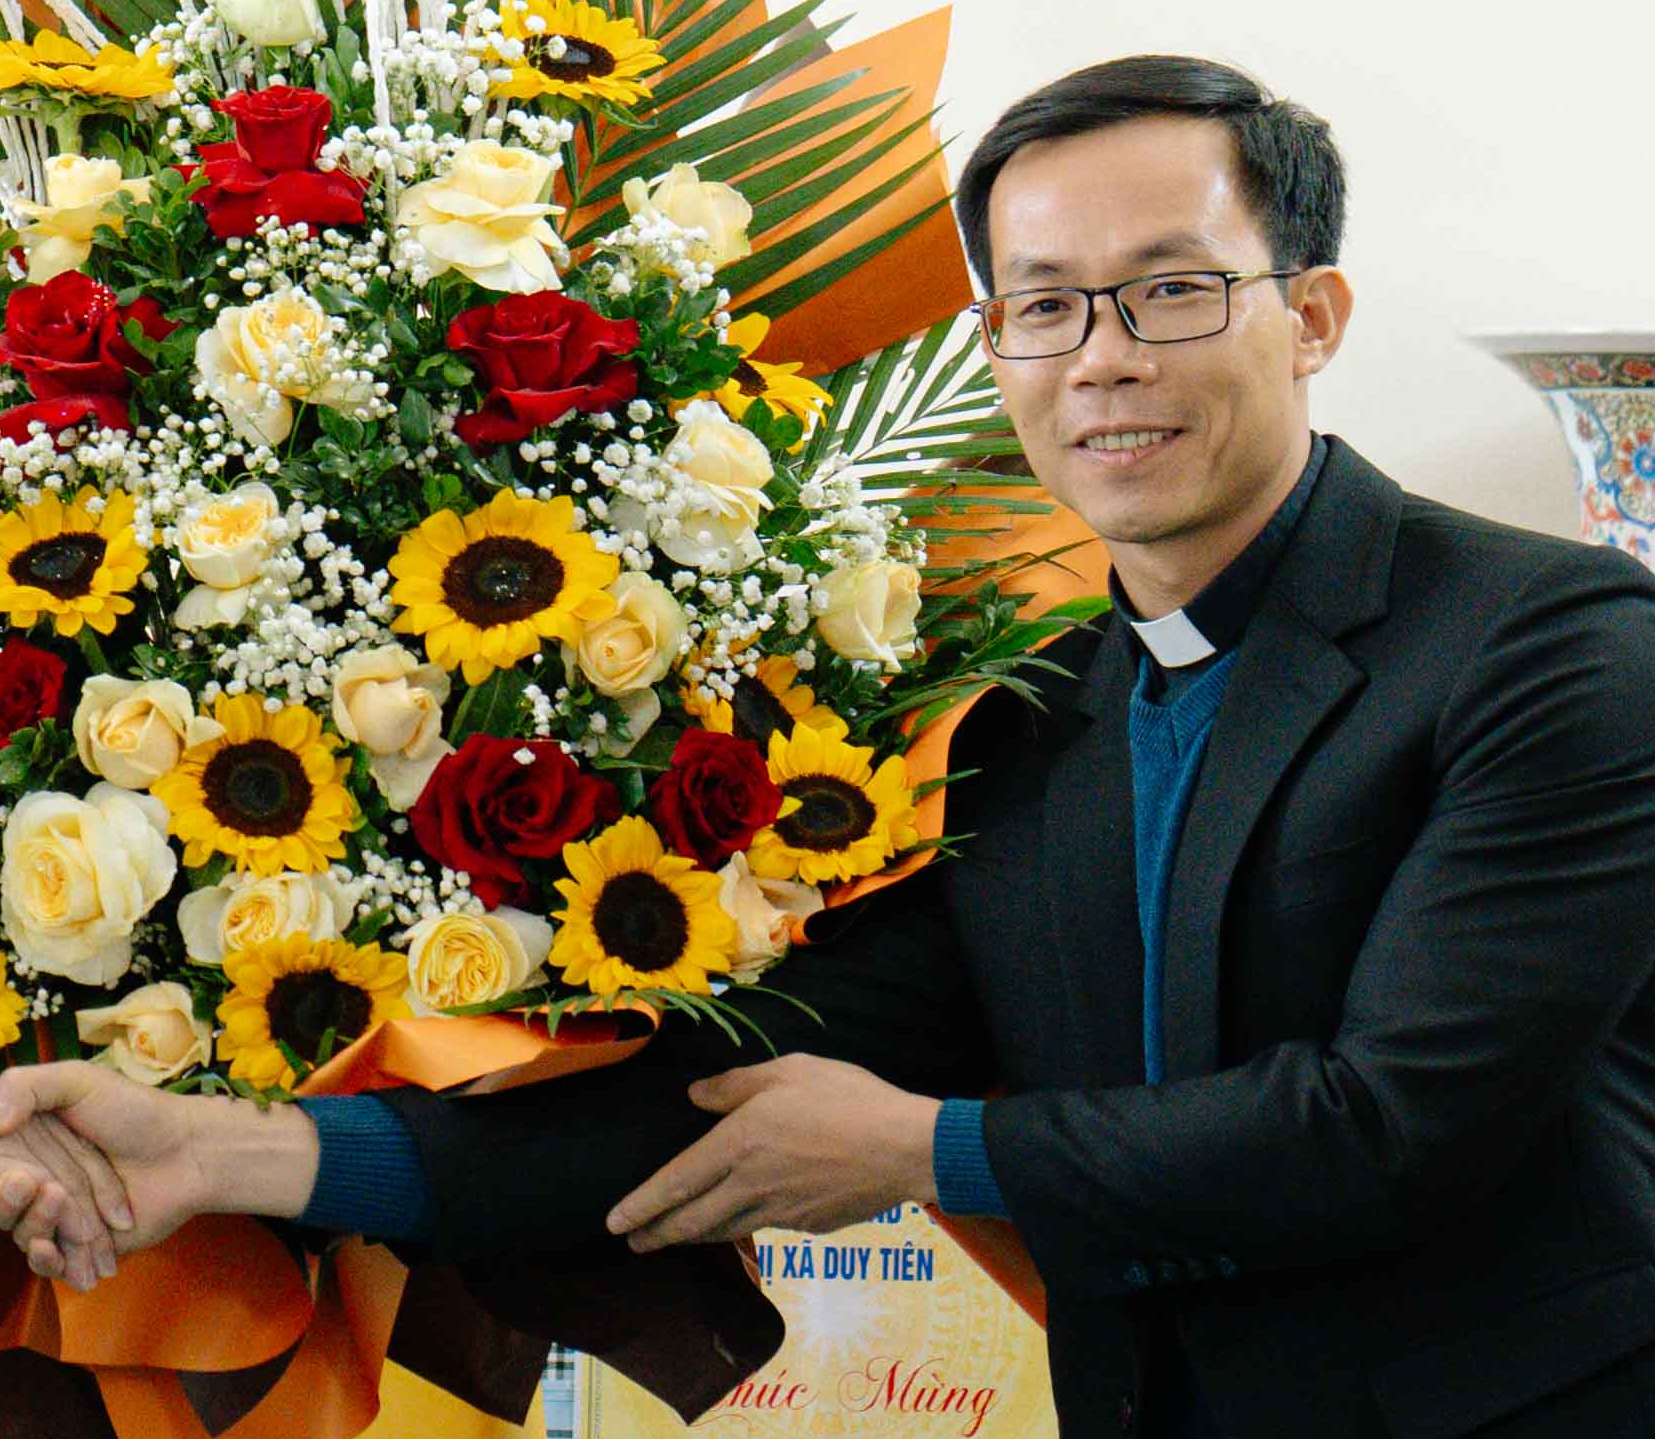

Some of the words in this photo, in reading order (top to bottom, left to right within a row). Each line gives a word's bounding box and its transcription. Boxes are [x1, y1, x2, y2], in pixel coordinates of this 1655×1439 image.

[781, 1239, 815, 1279] XÃ
[822, 1245, 871, 1281] DUY
[879, 1240, 934, 1282] TIÊN
[710, 1369, 820, 1414] húc
[837, 1356, 1000, 1438] Mừng
